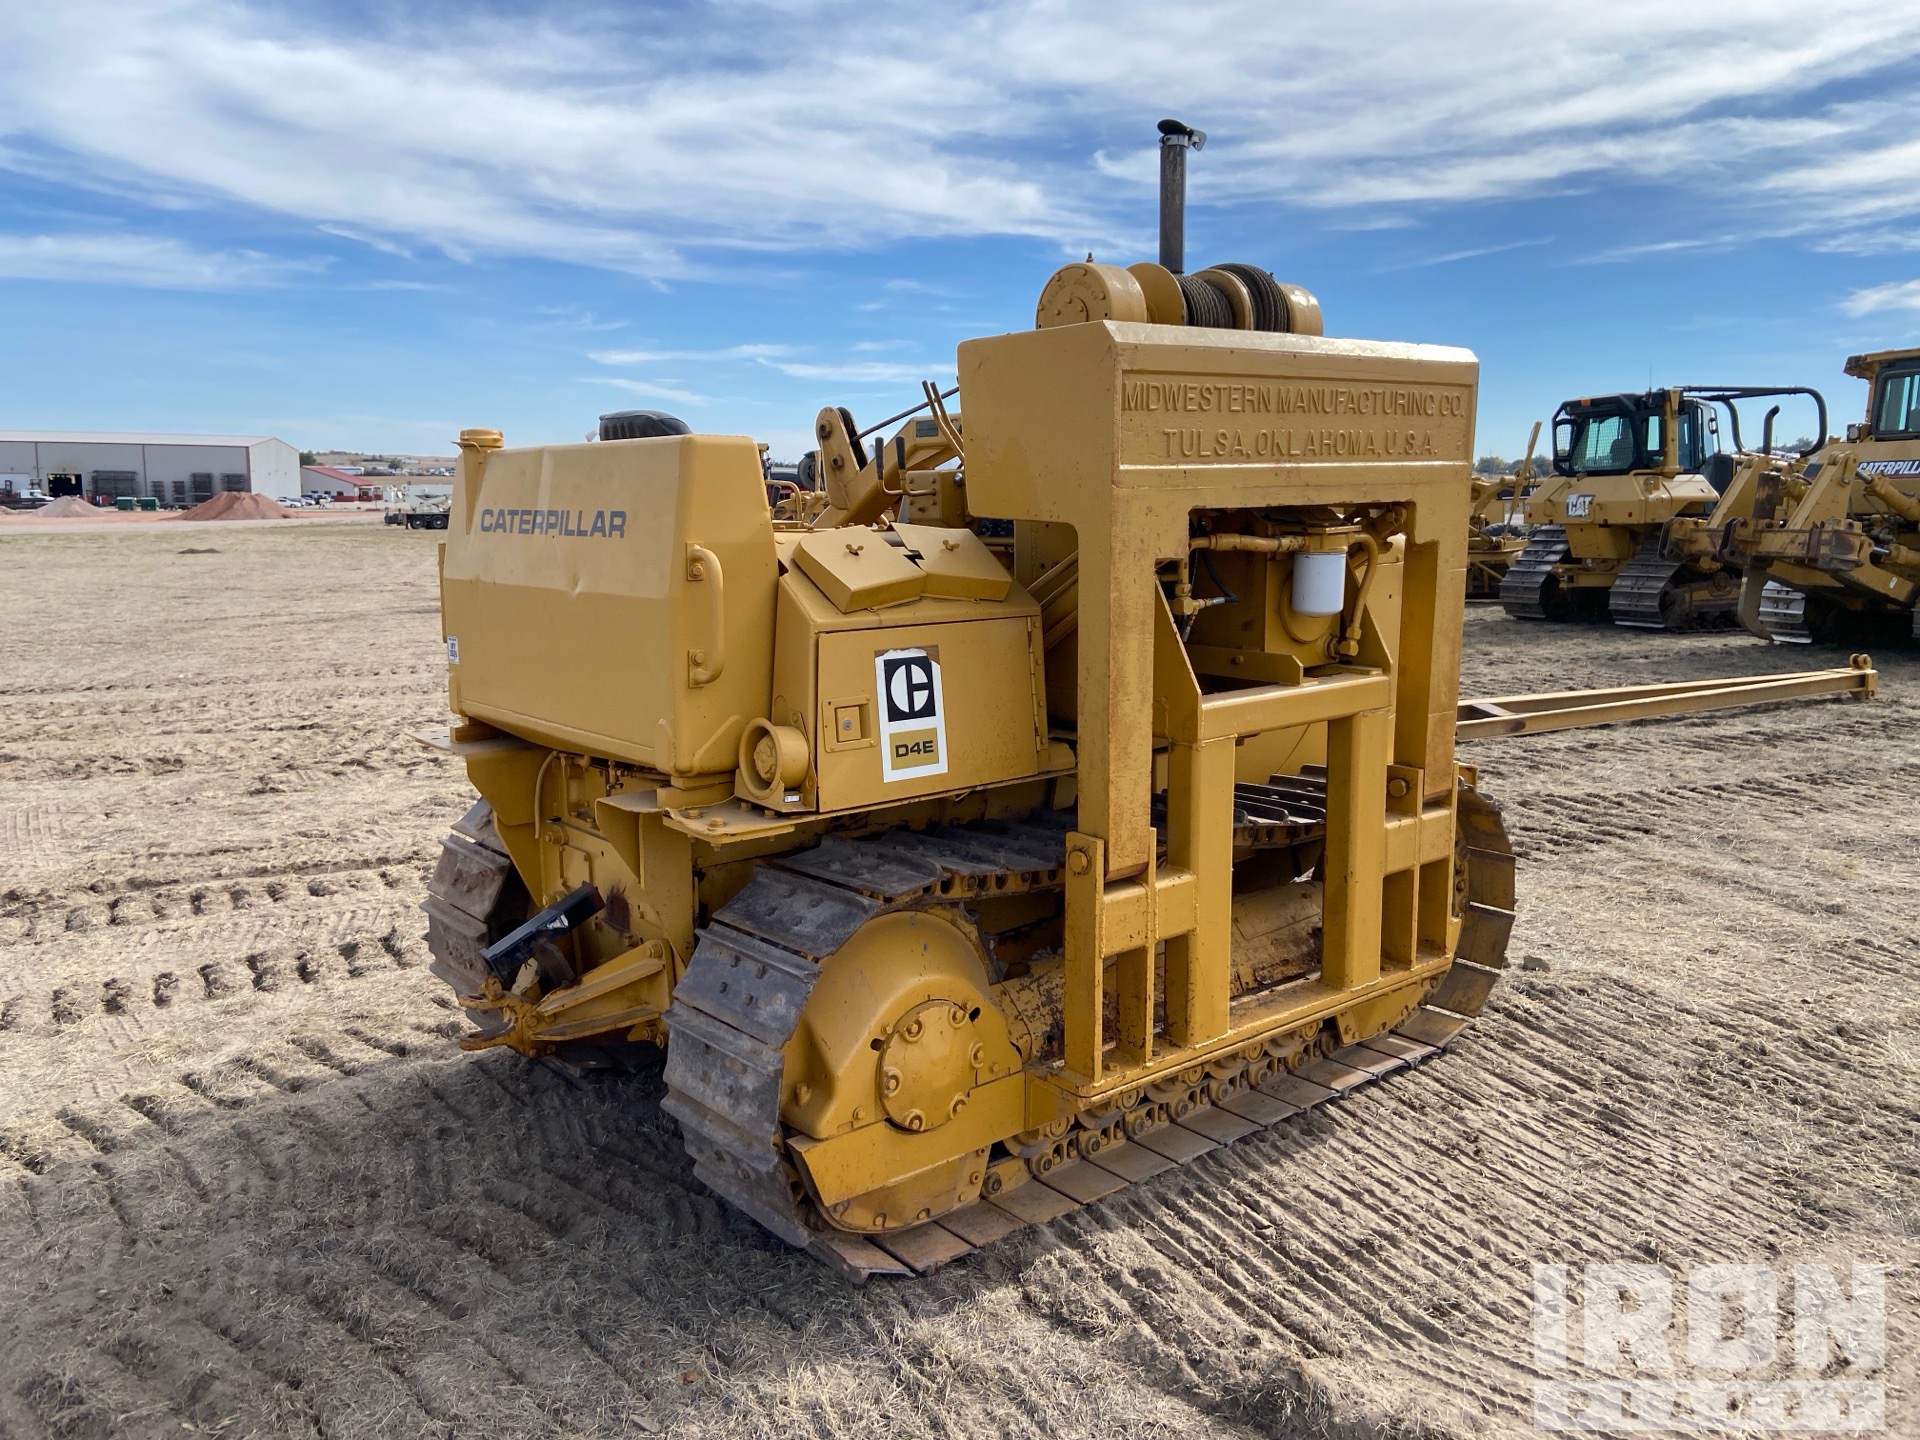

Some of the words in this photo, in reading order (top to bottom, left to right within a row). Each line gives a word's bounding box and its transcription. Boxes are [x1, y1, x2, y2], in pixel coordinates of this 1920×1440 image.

[1122, 381, 1272, 413] MIDWESTERN
[1277, 386, 1435, 417] MANUFACTURING
[1438, 392, 1465, 418] CO.
[1858, 460, 1920, 475] CATERPILL
[1568, 497, 1592, 517] CAT
[480, 508, 627, 539] CATERPILLAR
[895, 740, 934, 758] D4E
